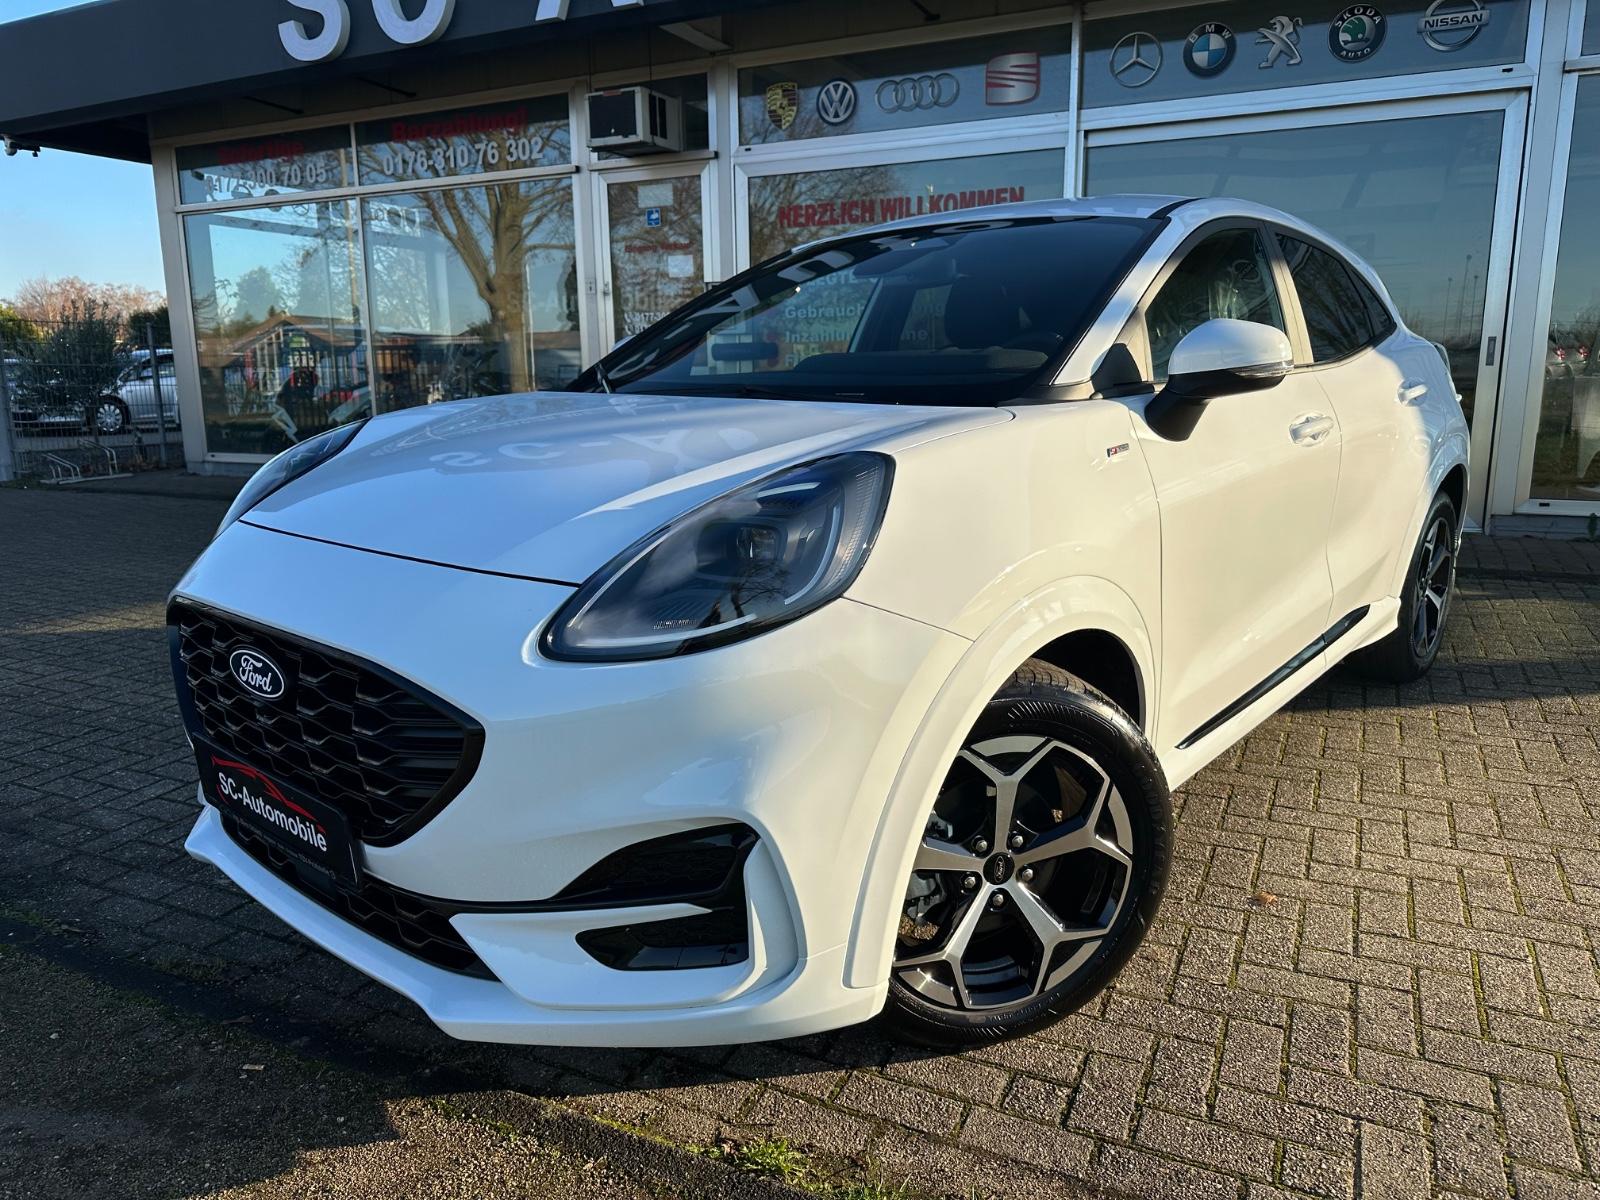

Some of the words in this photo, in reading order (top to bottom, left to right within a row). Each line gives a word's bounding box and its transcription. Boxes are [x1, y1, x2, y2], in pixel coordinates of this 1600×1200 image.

[1423, 12, 1484, 30] NISSAN
[1340, 46, 1371, 58] AUTO
[474, 140, 500, 165] 76
[505, 135, 544, 162] 302
[280, 164, 301, 187] 70
[305, 162, 327, 184] 05
[778, 197, 876, 229] HERZLICH
[879, 185, 1025, 222] WILLKOMMEN
[239, 655, 274, 692] Ford
[217, 770, 328, 853] SC-Automobile
